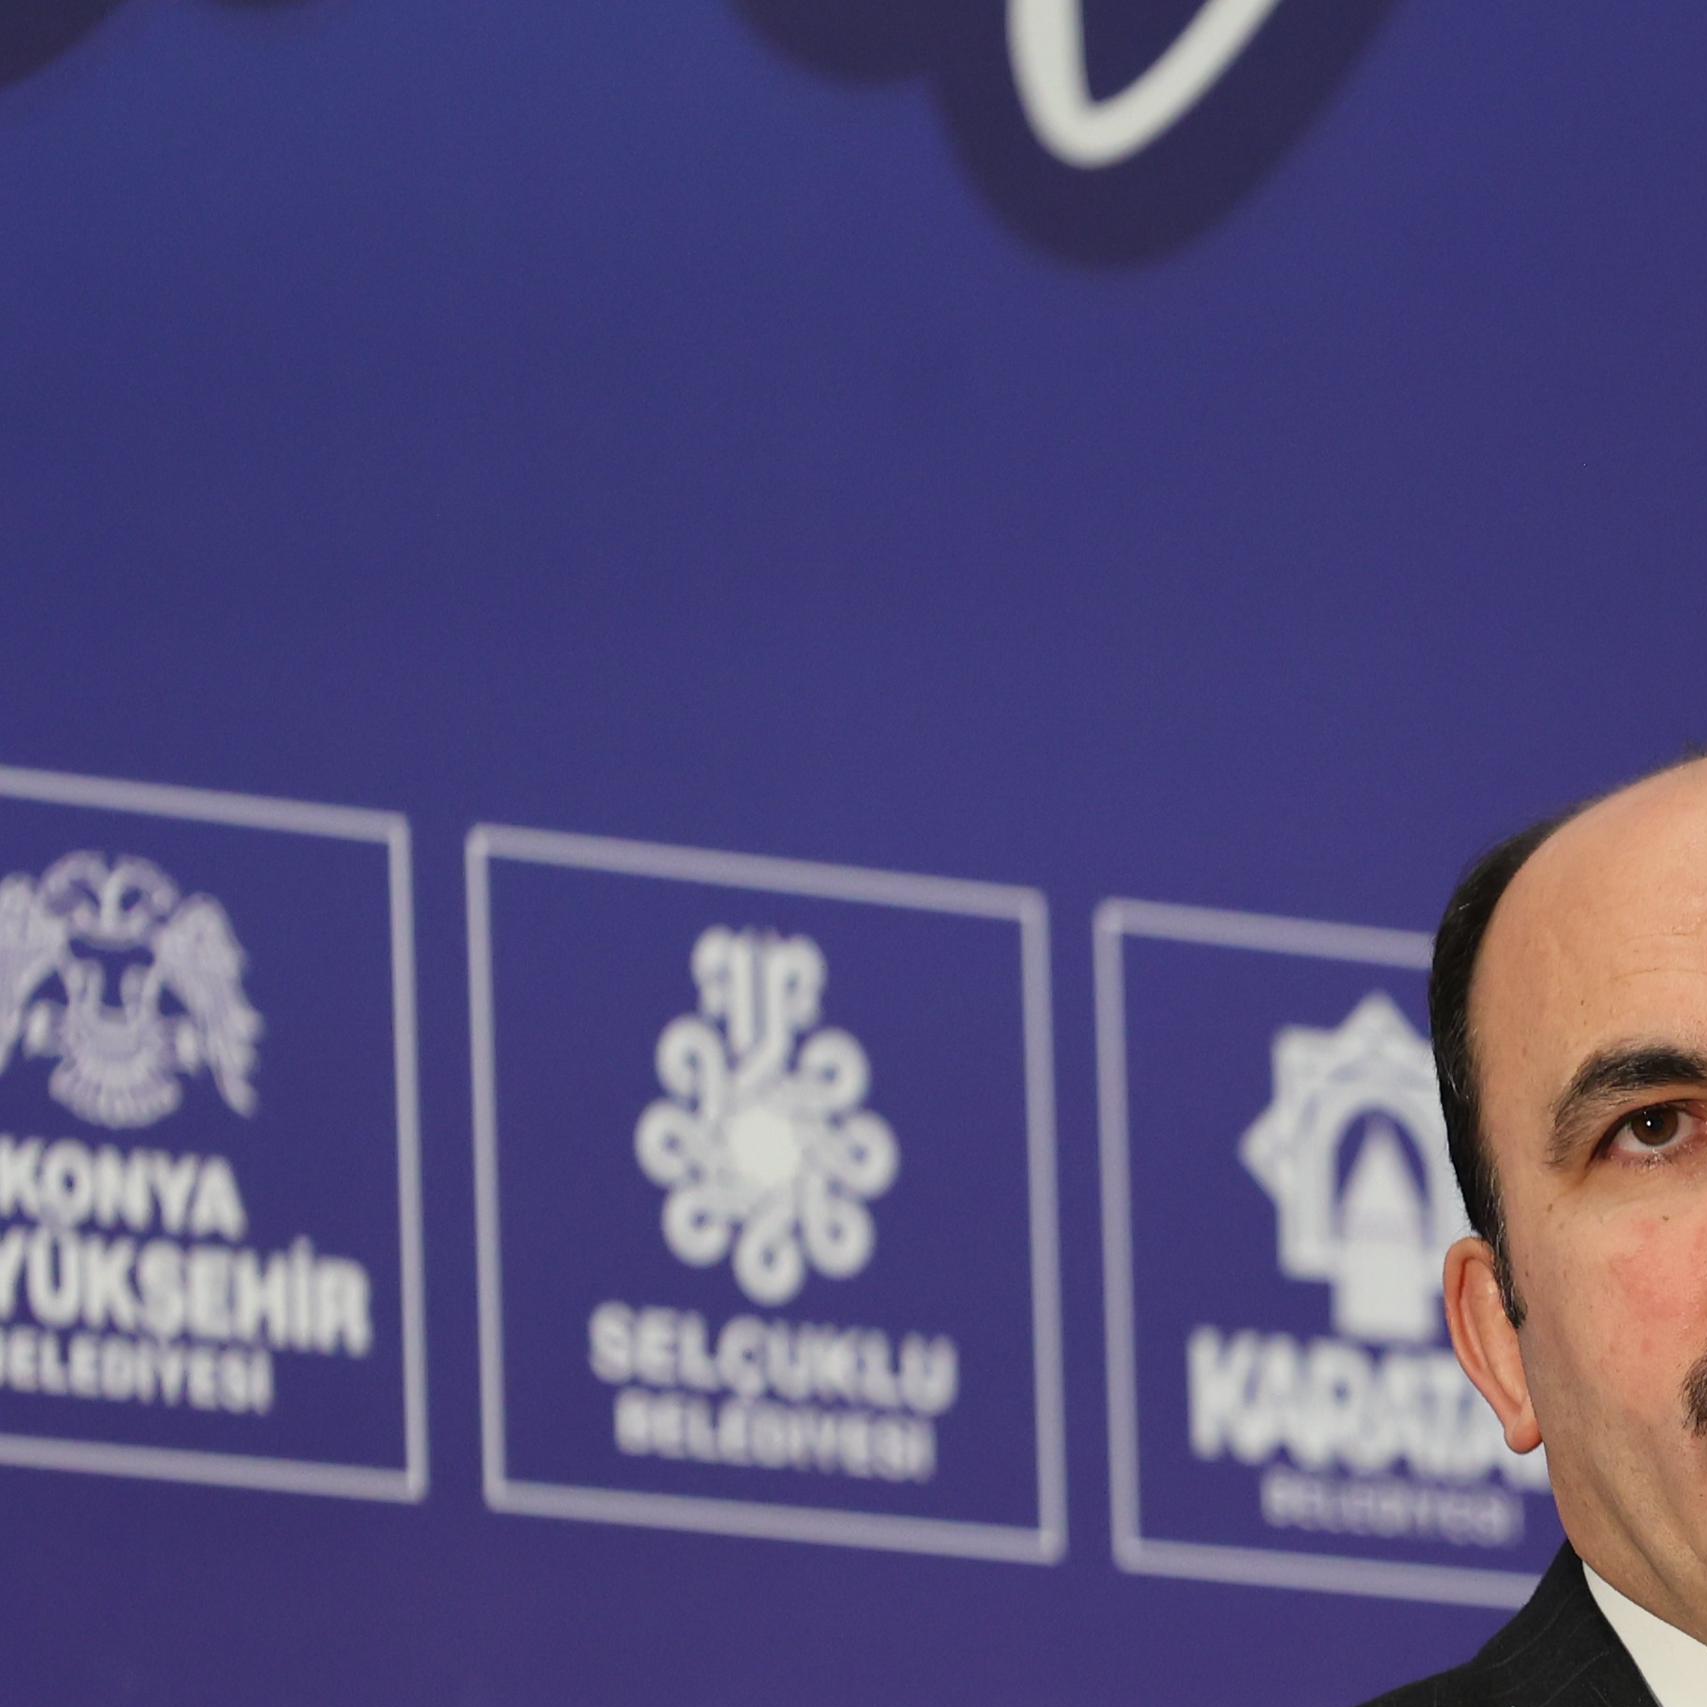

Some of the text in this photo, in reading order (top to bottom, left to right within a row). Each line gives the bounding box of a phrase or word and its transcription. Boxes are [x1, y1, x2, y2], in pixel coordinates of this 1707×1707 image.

[0, 1136, 247, 1240] KONYA
[0, 1327, 273, 1414] ELEDİYESİ
[590, 1303, 958, 1415] SELÇUKLU
[614, 1389, 937, 1482] BELEDİYESİ
